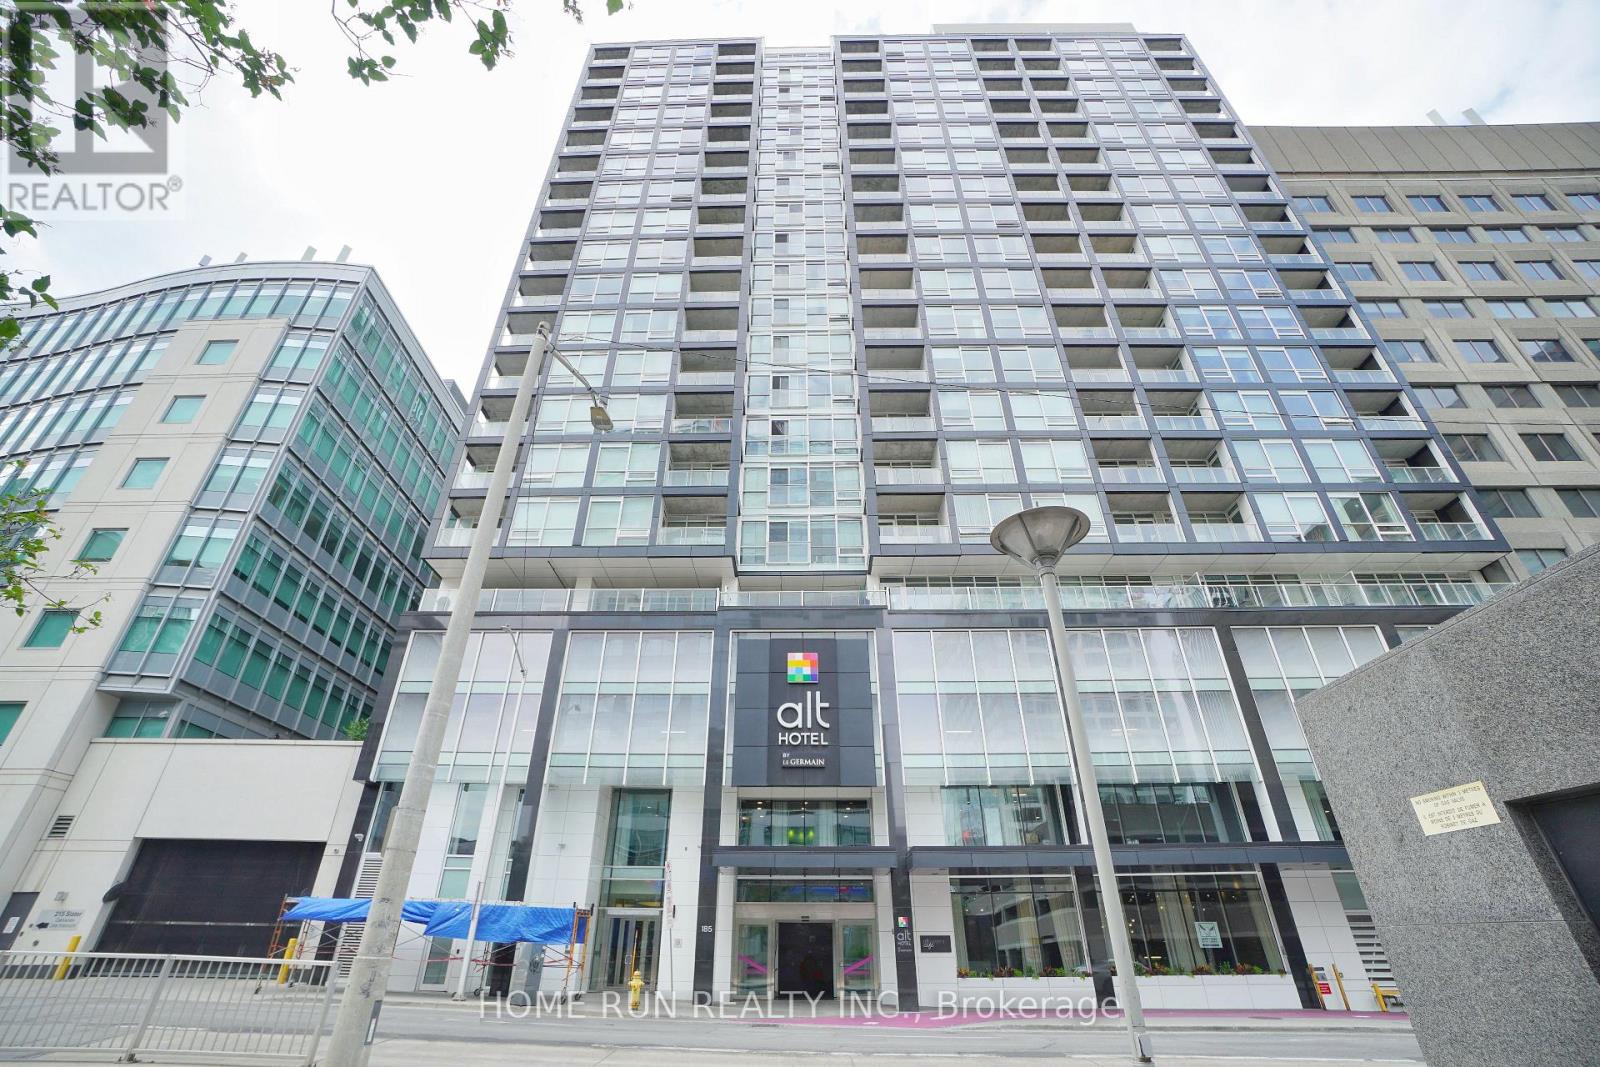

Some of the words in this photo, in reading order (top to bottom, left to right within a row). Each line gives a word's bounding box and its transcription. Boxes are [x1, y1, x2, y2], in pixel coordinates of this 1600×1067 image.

[777, 691, 830, 728] alt
[778, 732, 829, 745] HOTEL
[896, 929, 912, 941] alt
